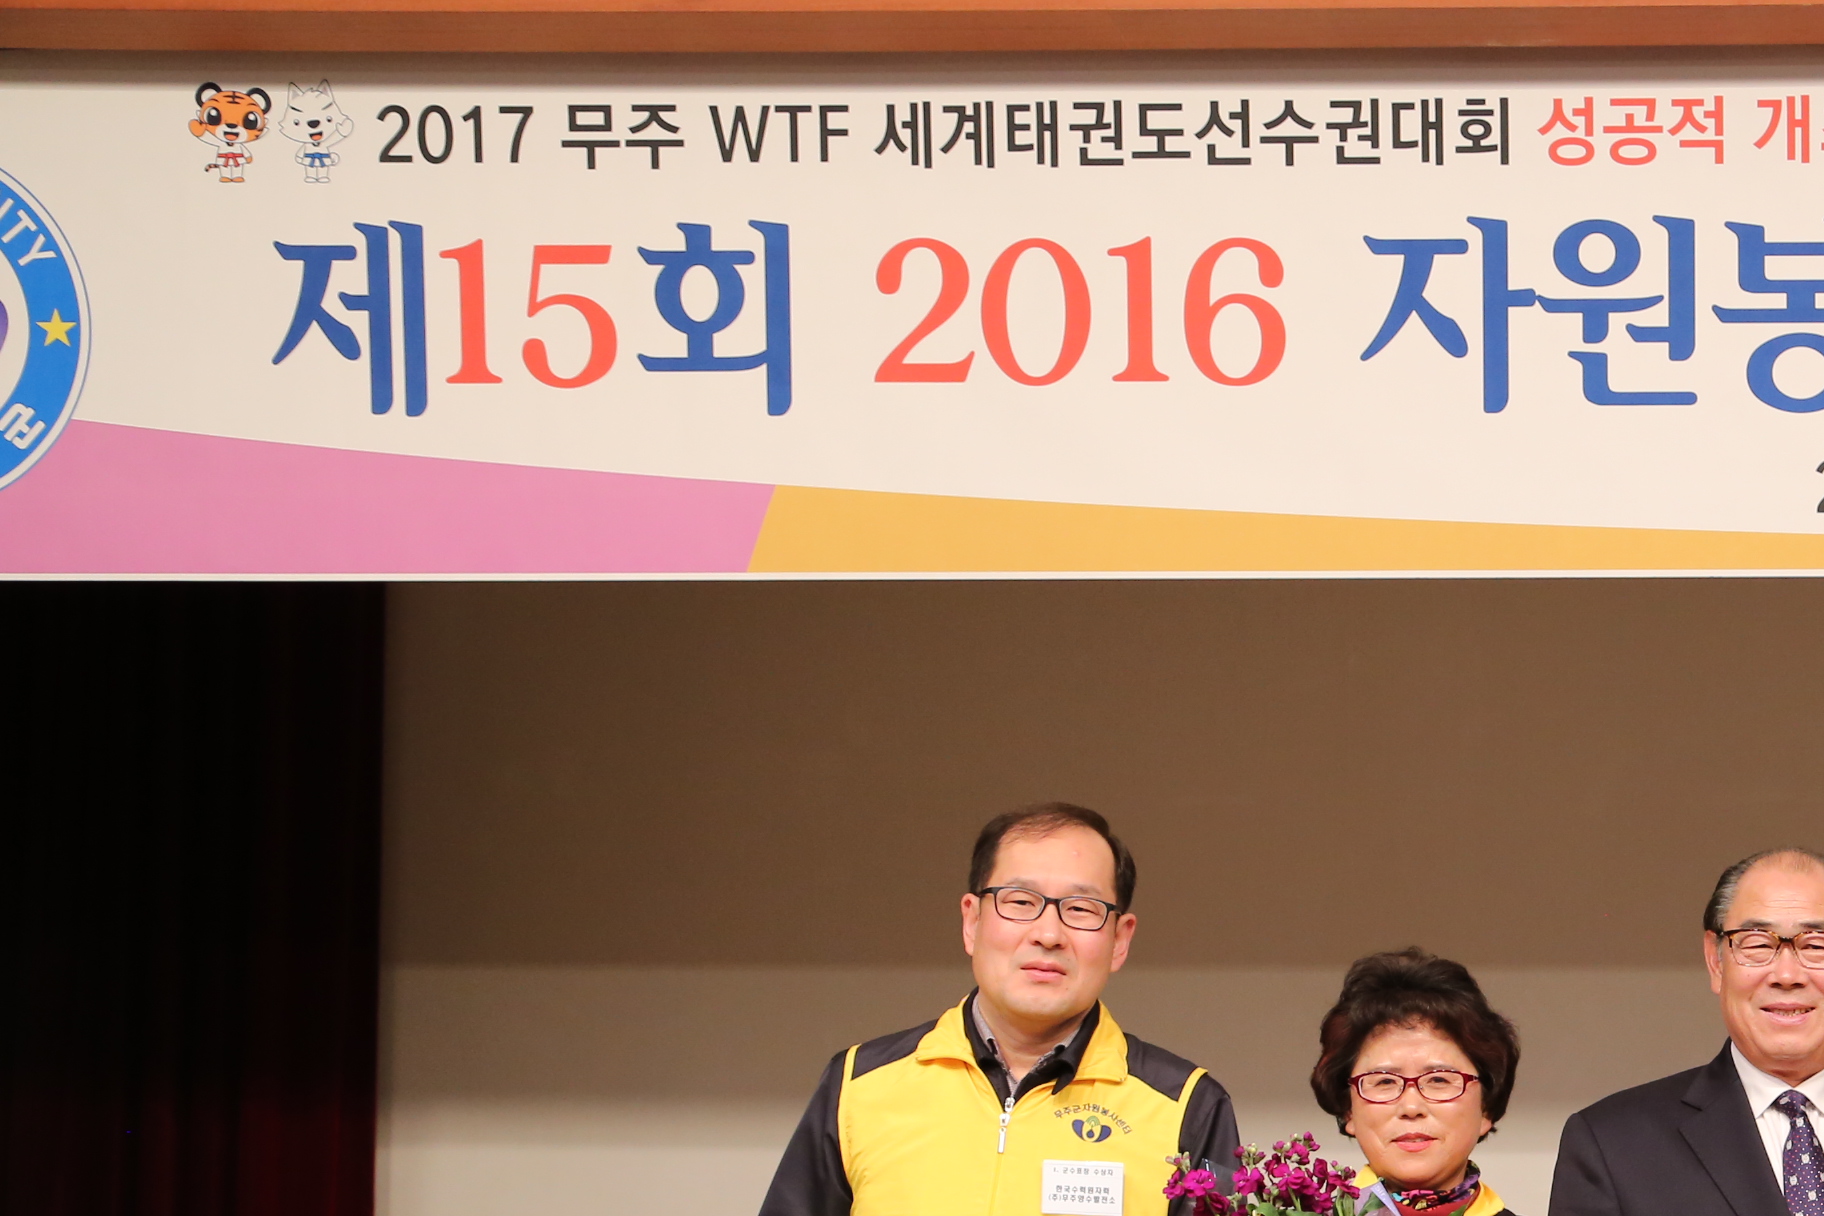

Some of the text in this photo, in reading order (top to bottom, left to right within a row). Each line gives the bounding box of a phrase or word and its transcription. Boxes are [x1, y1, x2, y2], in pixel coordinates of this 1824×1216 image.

[377, 105, 533, 164] 2017
[561, 104, 685, 170] 무주
[709, 105, 849, 163] WTF
[874, 98, 1510, 169] 세계태권도선수권대회
[1537, 95, 1725, 165] 성공적
[272, 219, 792, 417] 제15회
[874, 236, 1287, 386] 2016
